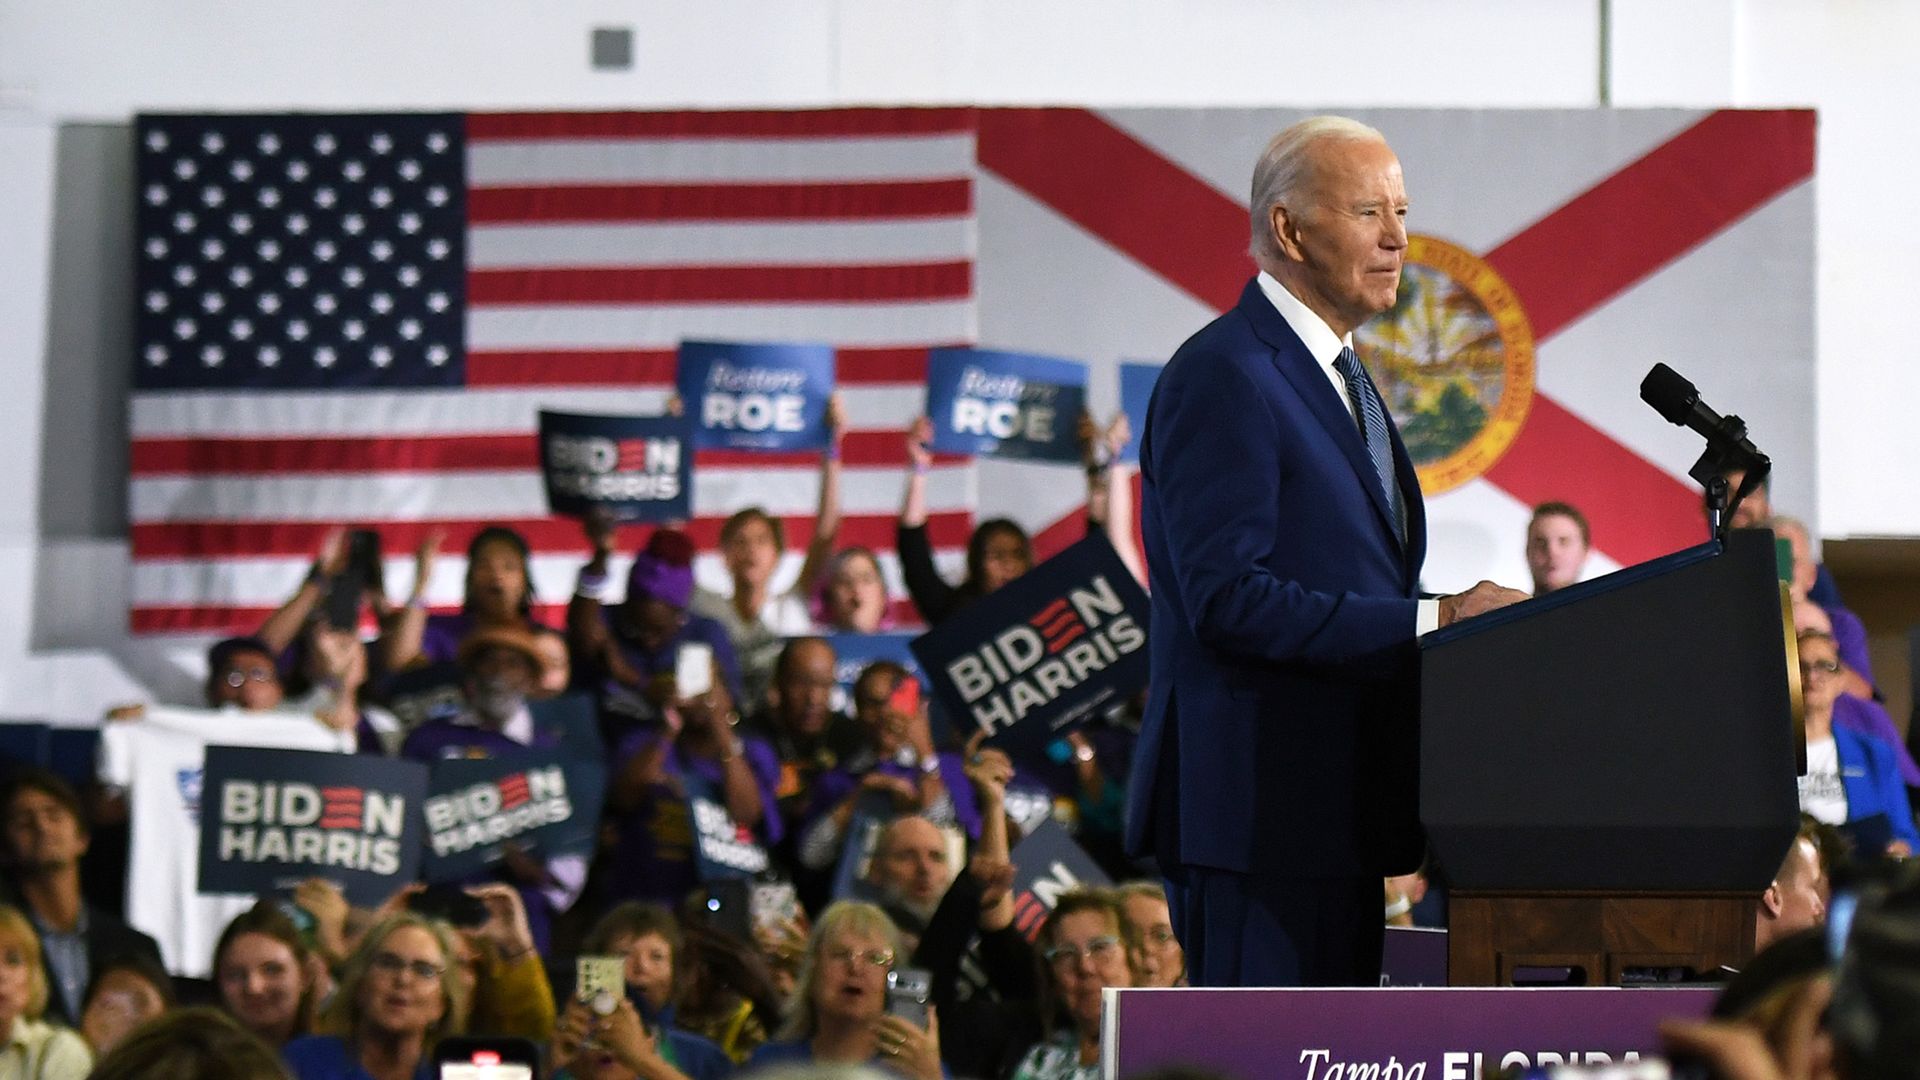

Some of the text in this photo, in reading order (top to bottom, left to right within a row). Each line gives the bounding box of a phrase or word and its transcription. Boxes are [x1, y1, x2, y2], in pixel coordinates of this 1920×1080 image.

[703, 393, 805, 431] ROE
[953, 397, 1055, 442] ROE
[948, 575, 1124, 703] BIDEN
[971, 614, 1145, 737] HARRIS
[223, 780, 405, 838] BIDEN
[425, 764, 566, 834] BIDEN
[219, 825, 401, 875] HARRIS
